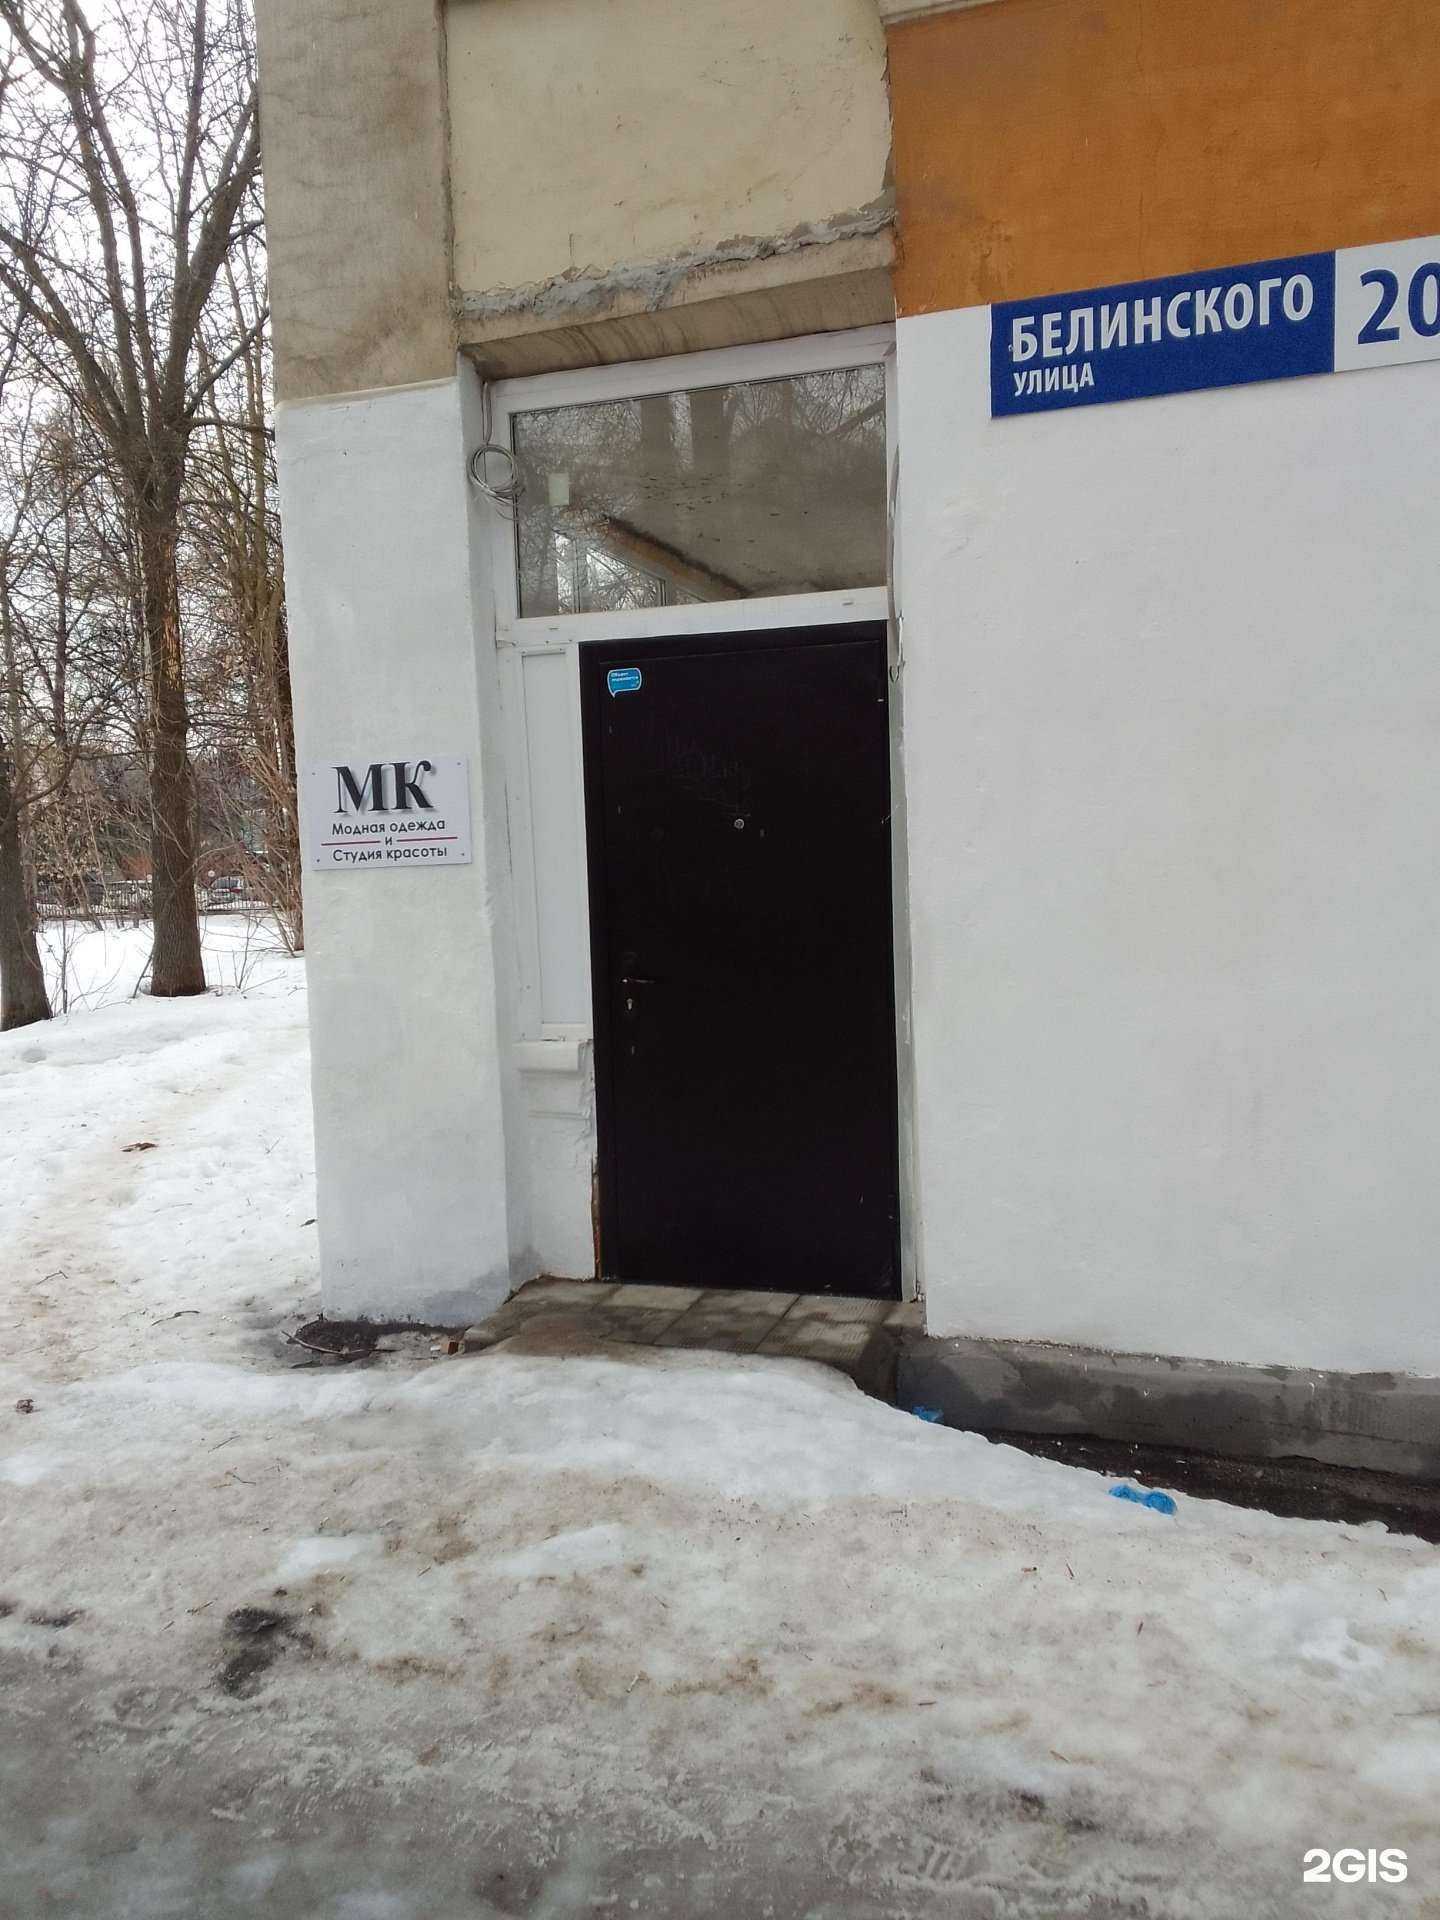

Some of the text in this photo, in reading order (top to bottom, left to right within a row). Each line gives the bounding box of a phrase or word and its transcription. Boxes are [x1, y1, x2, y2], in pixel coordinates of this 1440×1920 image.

[1011, 273, 1315, 363] БЕЛИНСКОГО
[1357, 261, 1440, 345] 20
[1013, 361, 1095, 397] УЛИЦА
[331, 760, 434, 814] МК
[332, 819, 446, 836] Модная одежда
[384, 836, 393, 846] и
[332, 847, 447, 863] Студия красоты
